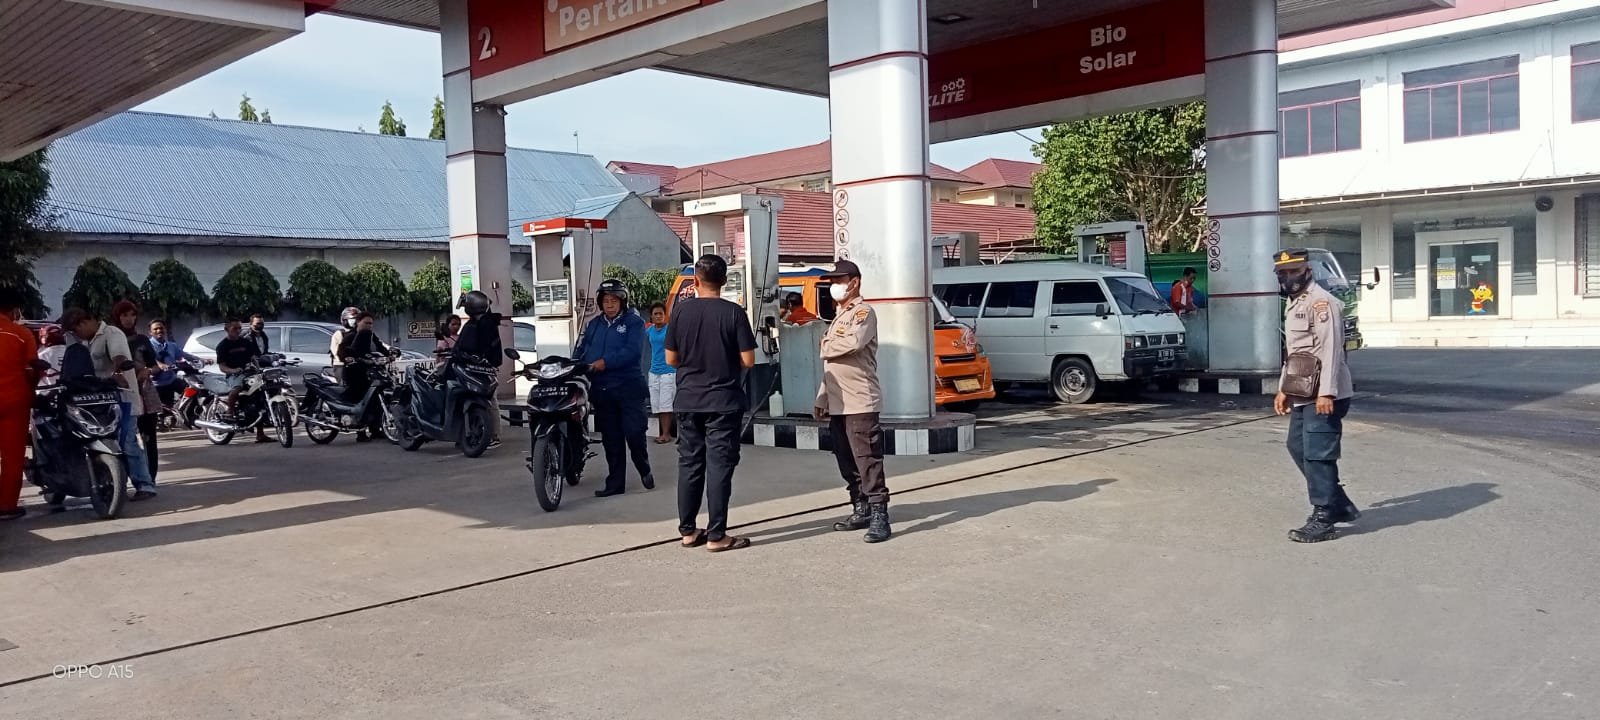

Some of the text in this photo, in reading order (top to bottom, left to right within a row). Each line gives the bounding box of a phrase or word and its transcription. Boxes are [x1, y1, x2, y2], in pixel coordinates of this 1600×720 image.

[559, 0, 668, 37] Perta
[478, 27, 497, 61] 2.
[1090, 24, 1127, 47] Bio
[1079, 50, 1137, 74] Solar
